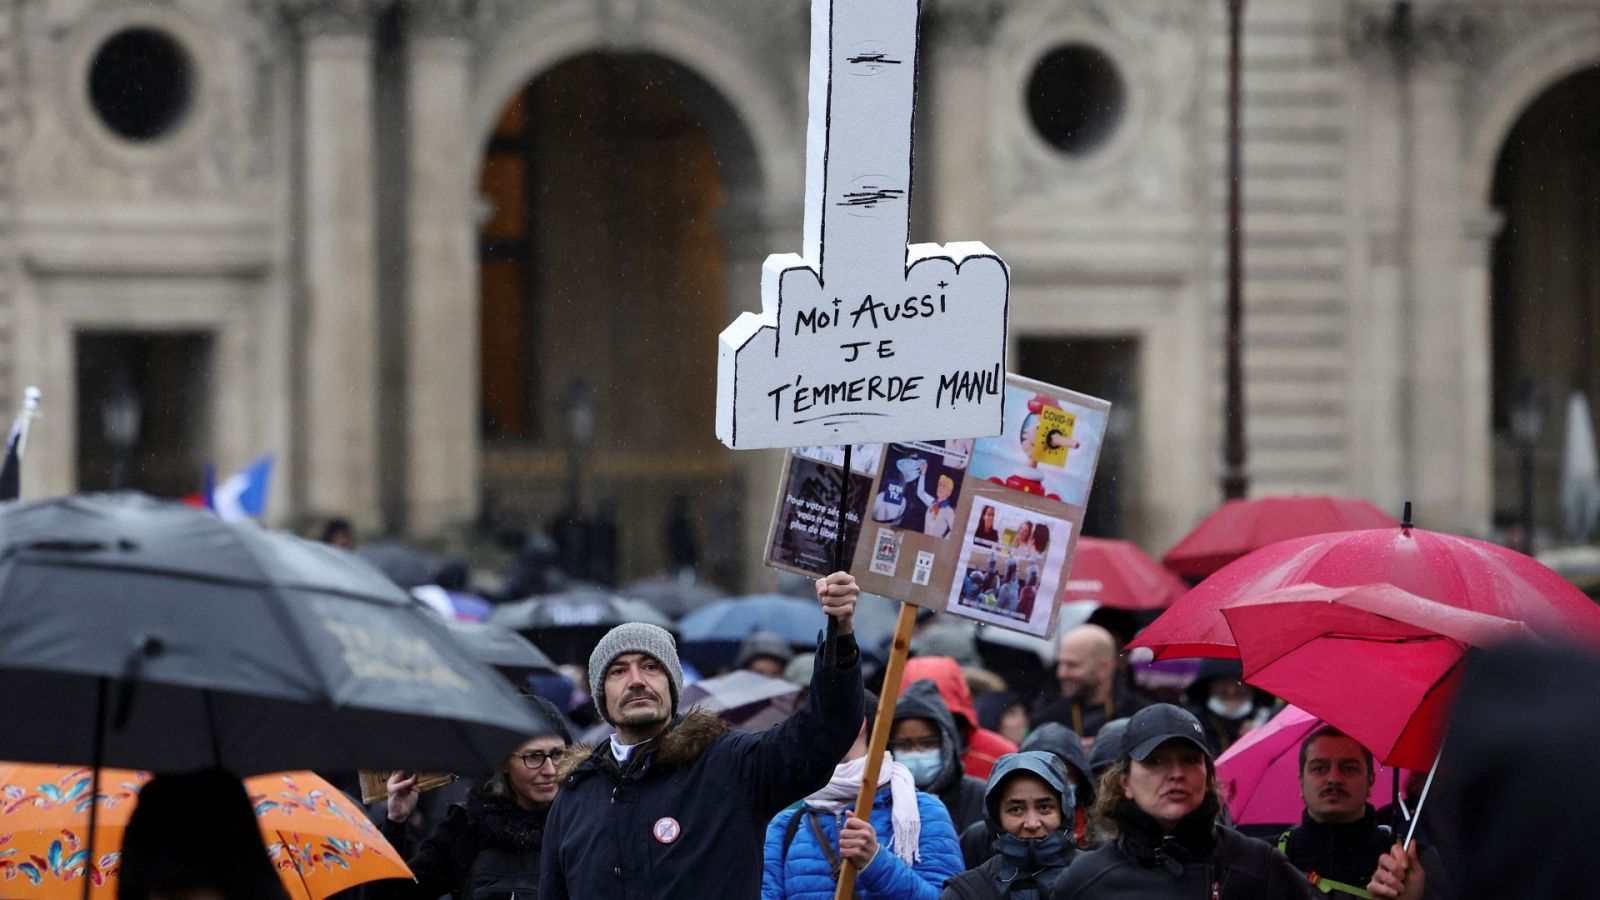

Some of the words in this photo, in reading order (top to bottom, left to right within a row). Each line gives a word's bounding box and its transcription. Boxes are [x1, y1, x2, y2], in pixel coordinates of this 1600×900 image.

[840, 340, 895, 362] JE
[936, 363, 1000, 409] MANU
[1043, 410, 1075, 427] COVID-19
[786, 494, 805, 507] Pour
[806, 501, 827, 513] votre
[827, 507, 860, 523] sécrité,
[797, 510, 816, 522] vous
[789, 520, 807, 531] plus
[808, 524, 819, 535] de
